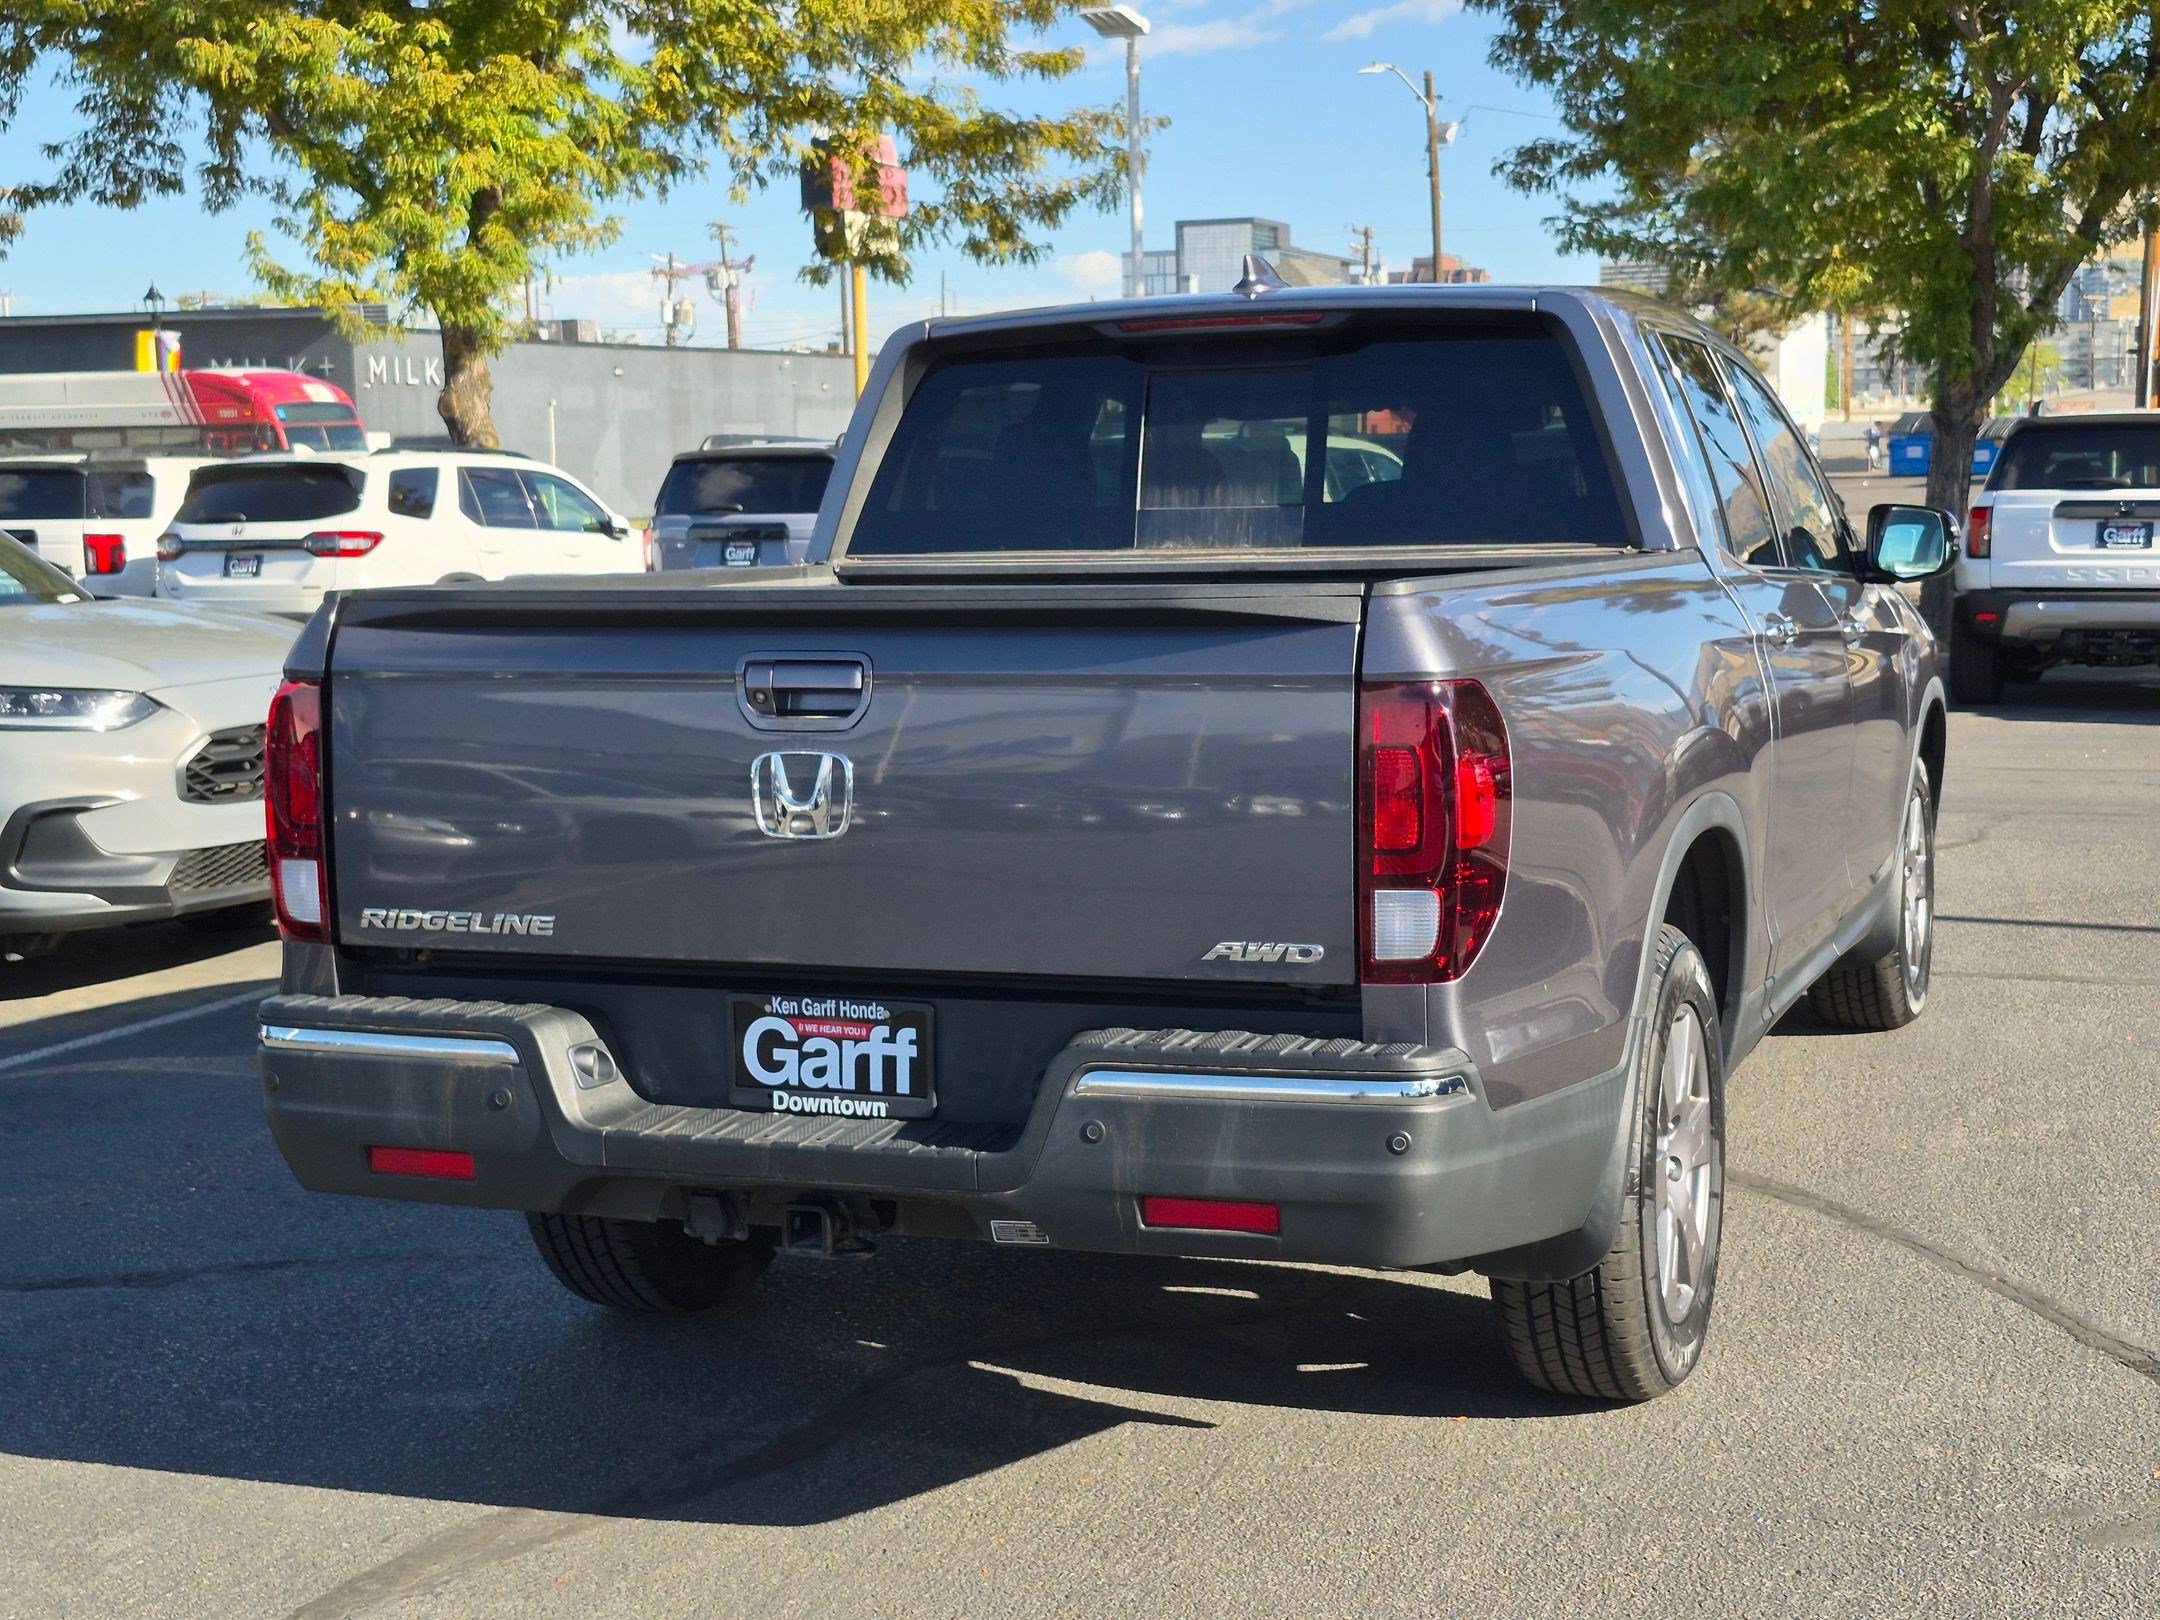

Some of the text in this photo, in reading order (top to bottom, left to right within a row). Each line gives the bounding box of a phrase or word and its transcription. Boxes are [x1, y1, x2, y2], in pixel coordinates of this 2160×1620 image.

[369, 354, 441, 385] MILK
[2103, 527, 2147, 543] Garff
[725, 546, 756, 560] Garff
[359, 907, 556, 936] RIDGELINE
[1201, 941, 1325, 964] AWD
[771, 996, 886, 1020] Ken Garff Honda
[804, 1024, 861, 1036] WE HEAR YOU
[742, 1016, 918, 1095] Garff
[772, 1090, 887, 1118] Downtown
